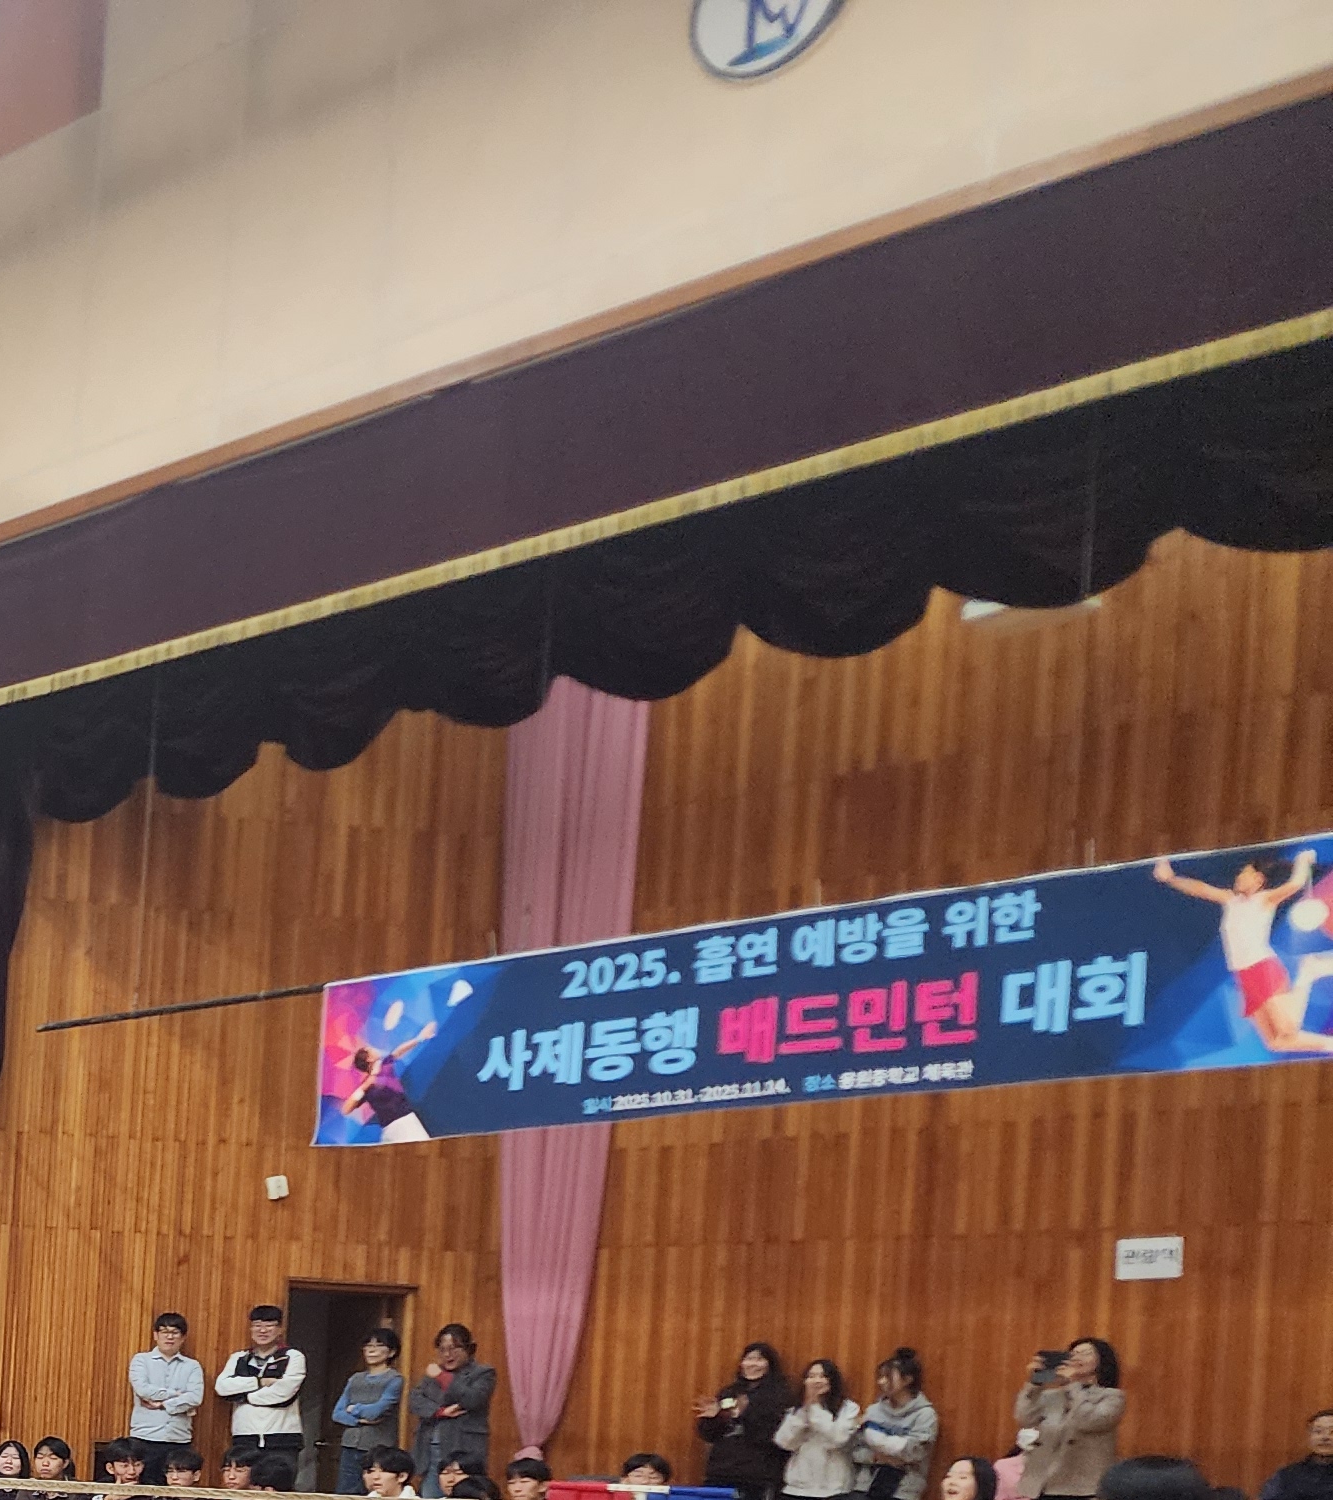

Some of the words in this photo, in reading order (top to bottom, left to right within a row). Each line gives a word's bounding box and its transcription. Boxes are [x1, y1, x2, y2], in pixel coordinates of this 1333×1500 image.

[559, 948, 681, 999] 2025.
[691, 924, 779, 985] 흡연
[793, 906, 930, 968] 예방을
[941, 888, 1042, 949] 위한
[476, 1005, 700, 1091] 사제동행
[716, 970, 980, 1063] 배드민턴
[999, 950, 1148, 1033] 대회
